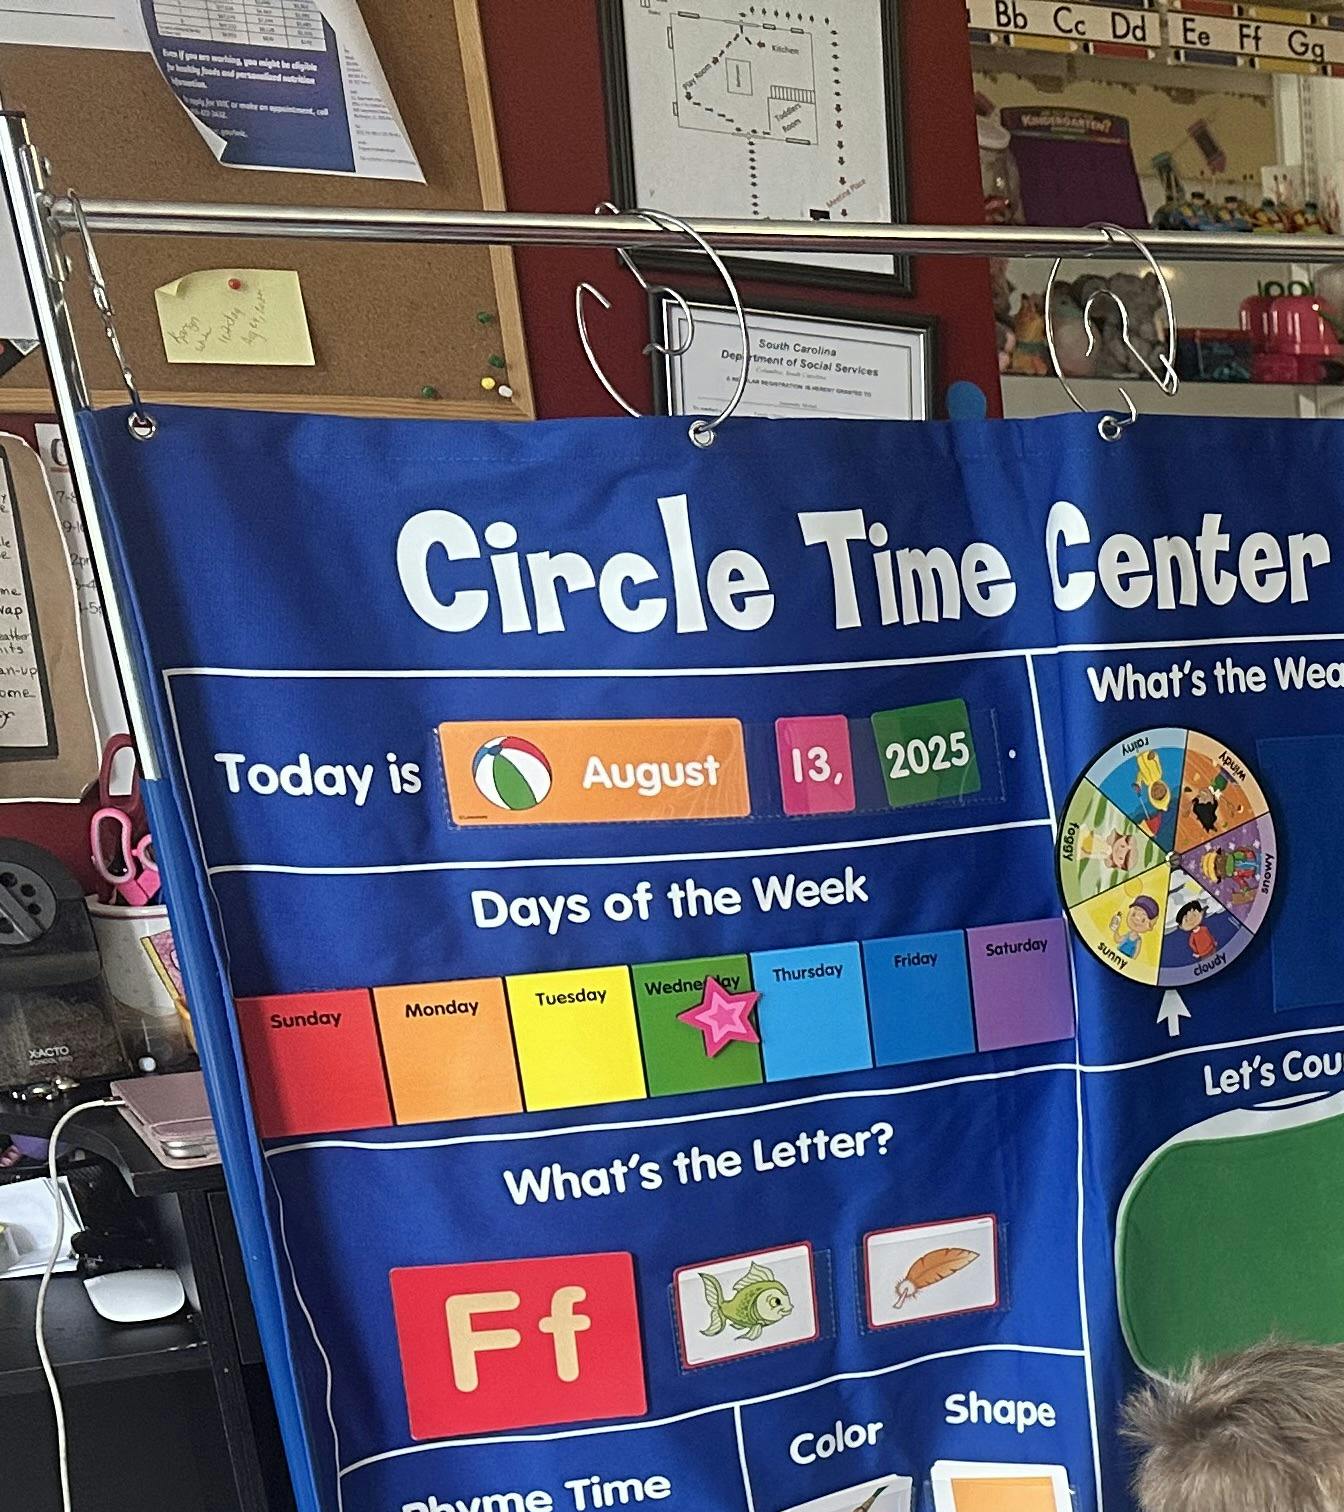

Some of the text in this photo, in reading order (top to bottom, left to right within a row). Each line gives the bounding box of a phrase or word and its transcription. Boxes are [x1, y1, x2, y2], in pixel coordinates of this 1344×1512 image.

[772, 44, 799, 55] Kitchen
[995, 3, 1027, 30] Bb
[1053, 7, 1087, 36] Cc
[1112, 12, 1147, 42] Dd
[1183, 17, 1210, 47] Ee
[1239, 24, 1263, 51] Ff
[1288, 29, 1325, 64] Gg
[185, 53, 197, 62] you
[199, 54, 210, 62] are
[212, 54, 242, 66] working,
[244, 58, 257, 67] you
[292, 61, 317, 72] eligible
[200, 66, 220, 77] foods
[222, 69, 235, 78] and
[694, 63, 711, 79] Room
[782, 118, 802, 133] Room
[721, 349, 879, 377] Deprtment of Social Services
[758, 339, 837, 357] South Carolina
[397, 494, 1332, 634] Circle Time Center
[1087, 659, 1207, 702] What's
[1213, 657, 1267, 694] the
[1121, 737, 1150, 757] rainy
[1218, 751, 1247, 781] windy
[214, 731, 970, 807] Today is August 13, 2025
[1067, 822, 1079, 861] foggy
[1261, 853, 1275, 895] snowy
[470, 866, 869, 936] Days of the Week
[1097, 942, 1128, 970] sunny
[1193, 953, 1227, 976] cloudy
[270, 937, 1048, 1029] Sunday Monday Tuesday Wedneay Thursday Friday Saturday
[1203, 1054, 1275, 1096] Let's
[502, 1121, 894, 1206] What's the Letter?
[444, 1284, 592, 1393] Ff
[789, 1390, 1056, 1465] Color Shape
[563, 1475, 672, 1512] Time
